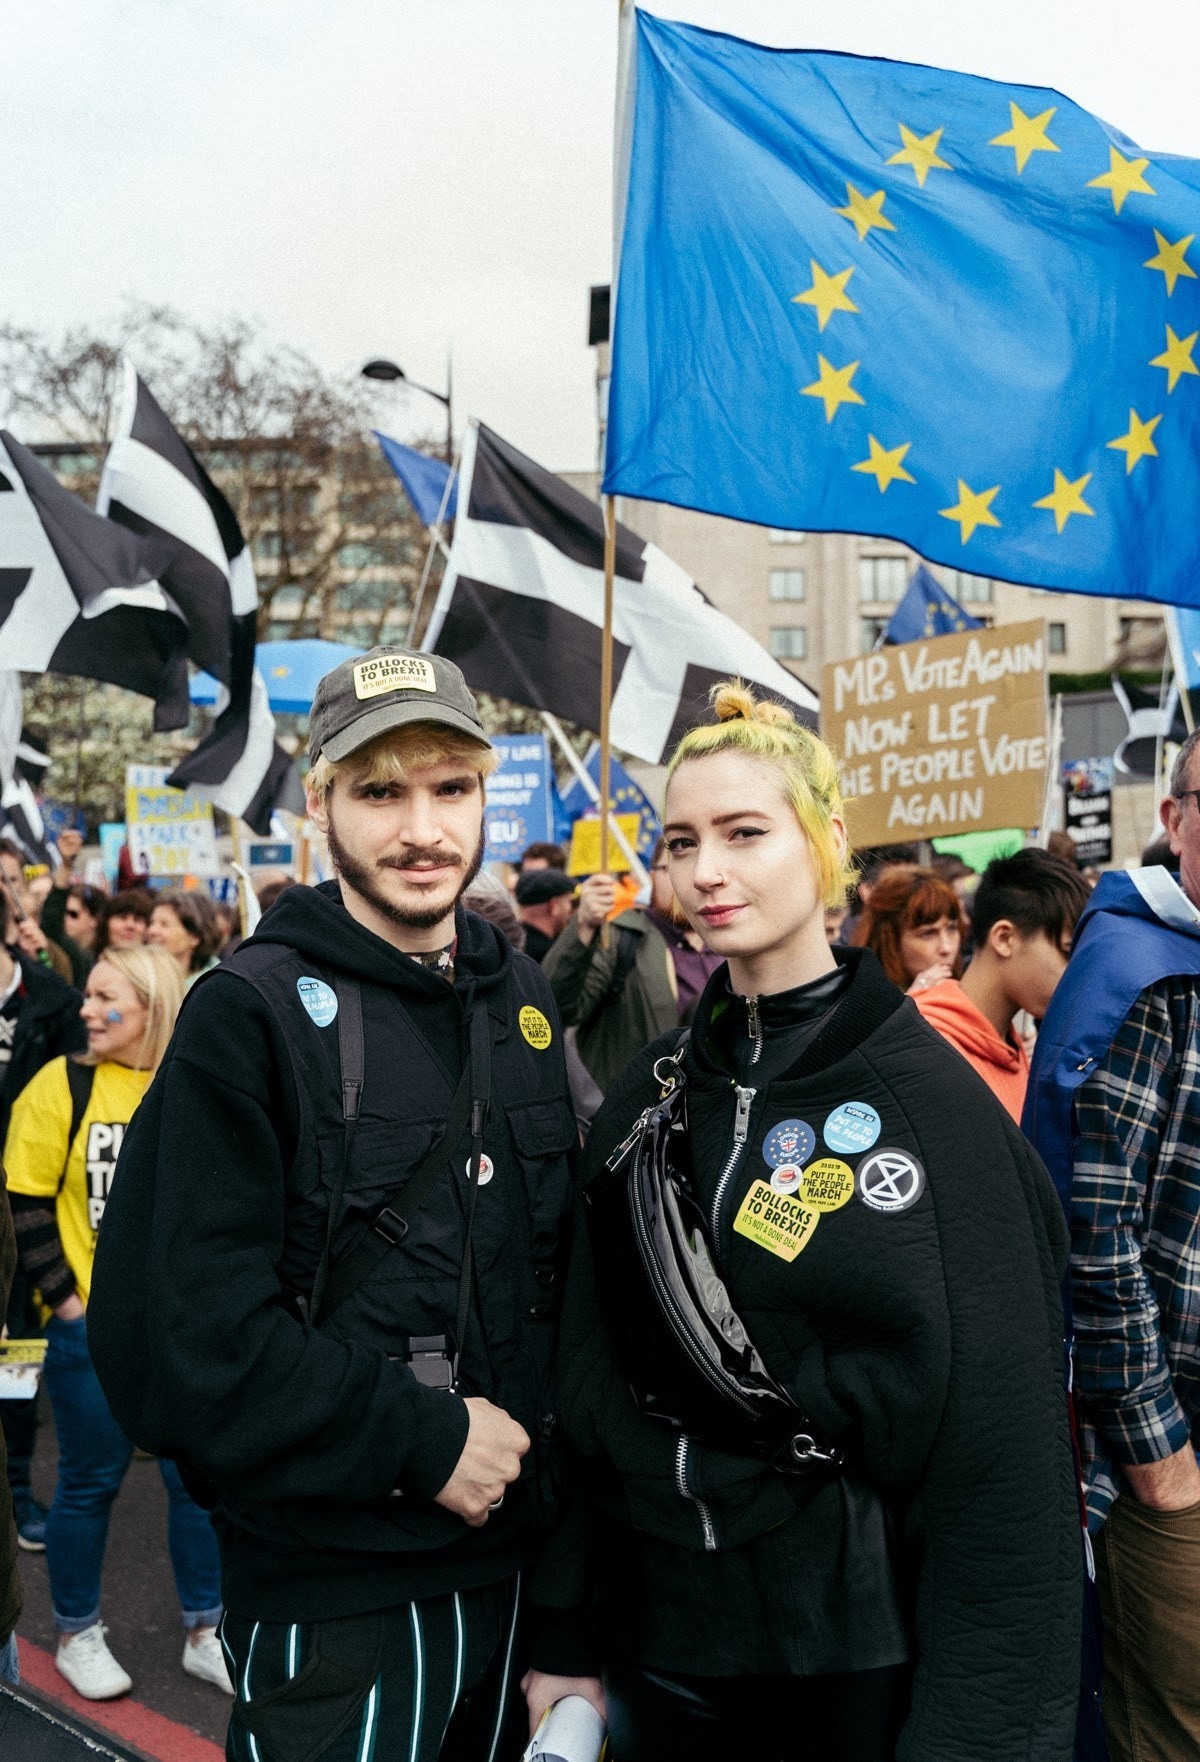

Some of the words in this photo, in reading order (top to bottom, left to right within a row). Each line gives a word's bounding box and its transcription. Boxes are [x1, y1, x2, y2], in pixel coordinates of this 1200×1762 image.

[360, 672, 376, 682] TO
[382, 666, 427, 676] BREXIT
[361, 659, 425, 674] BOLLOCKS
[844, 711, 912, 758] NOW
[928, 695, 997, 744] LET
[881, 748, 976, 792] PEOPLE
[978, 734, 1046, 778] VOTE
[887, 788, 984, 828] AGAIN
[489, 820, 519, 842] EU
[528, 1030, 548, 1038] MARCH
[826, 1122, 842, 1133] THE
[842, 1128, 872, 1146] PEOPLE
[834, 1116, 851, 1126] PUT
[862, 1126, 872, 1136] TO
[803, 1178, 818, 1187] THE
[820, 1180, 852, 1191] PEOPLE
[837, 1174, 846, 1182] TO
[807, 1188, 842, 1200] MARCH
[754, 1186, 812, 1225] BOLLOCKS
[748, 1198, 762, 1214] TO
[764, 1208, 807, 1238] BREXIT
[742, 1214, 752, 1225] IT'S
[752, 1220, 764, 1230] NOT
[763, 1226, 768, 1234] A
[768, 1228, 784, 1242] DONE
[782, 1236, 798, 1250] DEAL
